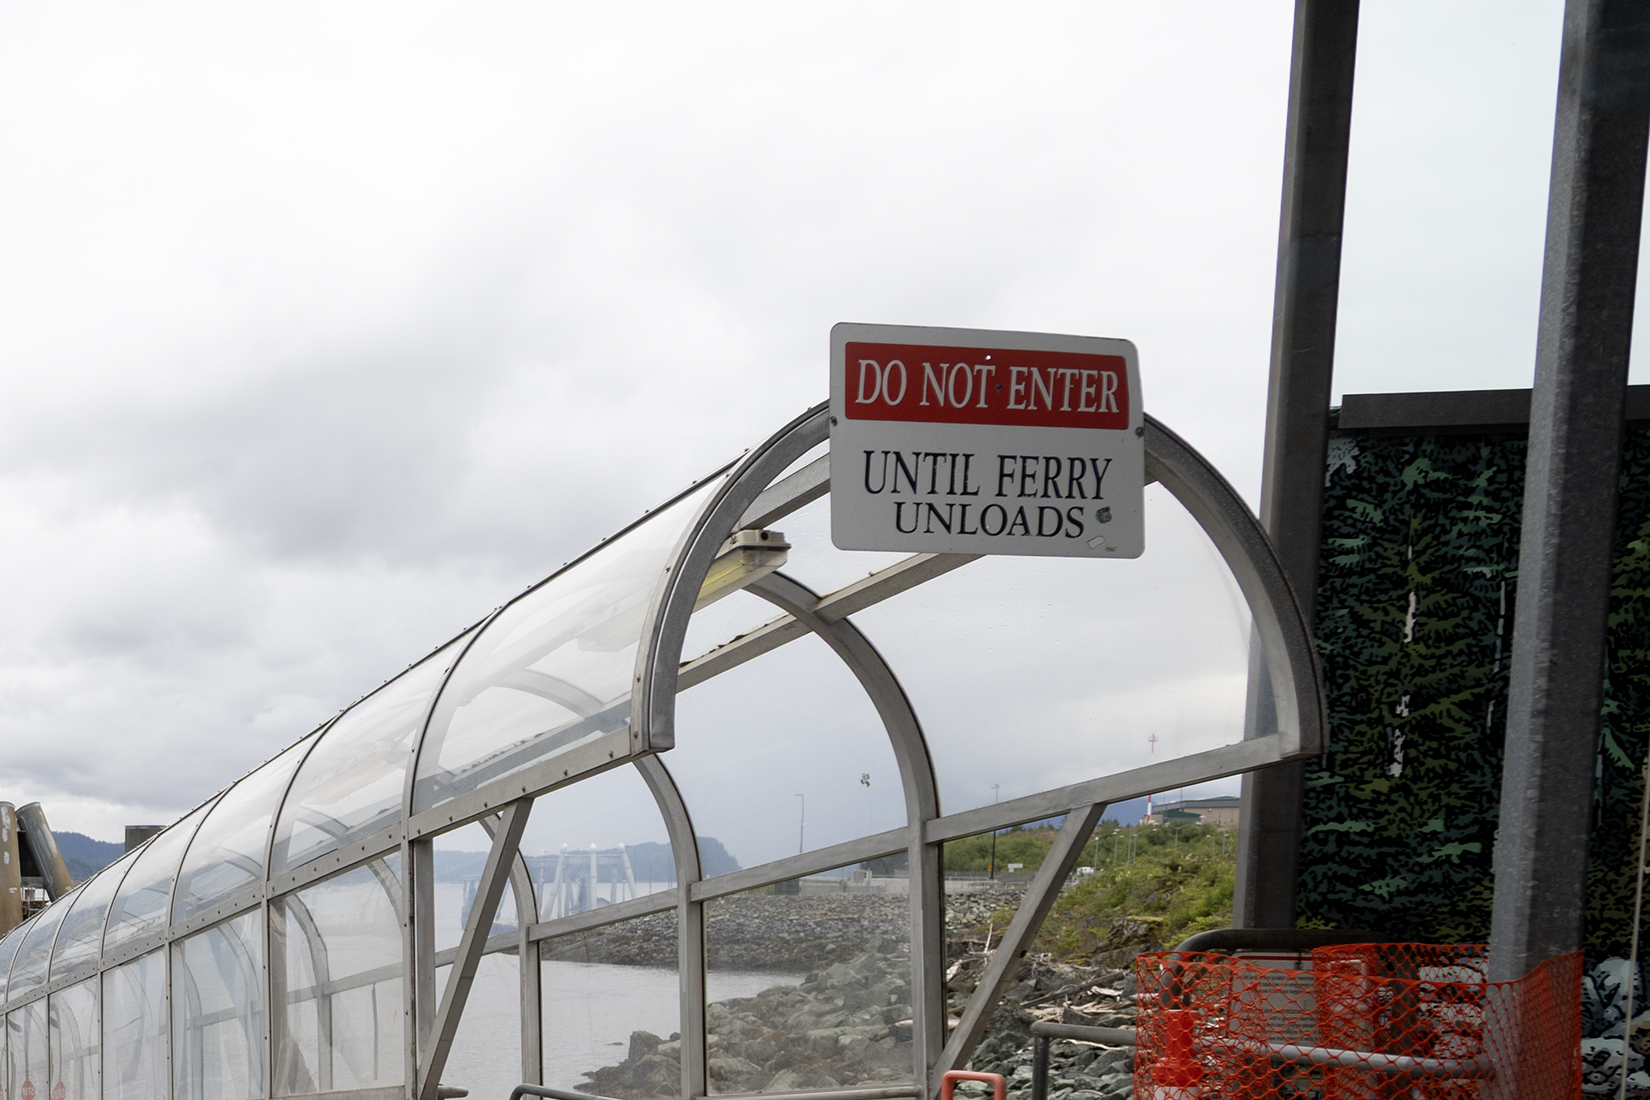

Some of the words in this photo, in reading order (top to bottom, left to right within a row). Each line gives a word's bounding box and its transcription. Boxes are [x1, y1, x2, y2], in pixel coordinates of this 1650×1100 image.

[855, 359, 907, 406] DO
[919, 362, 996, 409] NOT
[1006, 366, 1120, 413] ENTER
[863, 450, 981, 497] UNTIL
[995, 454, 1113, 500] FERRY
[894, 501, 1085, 539] UNLOADS
